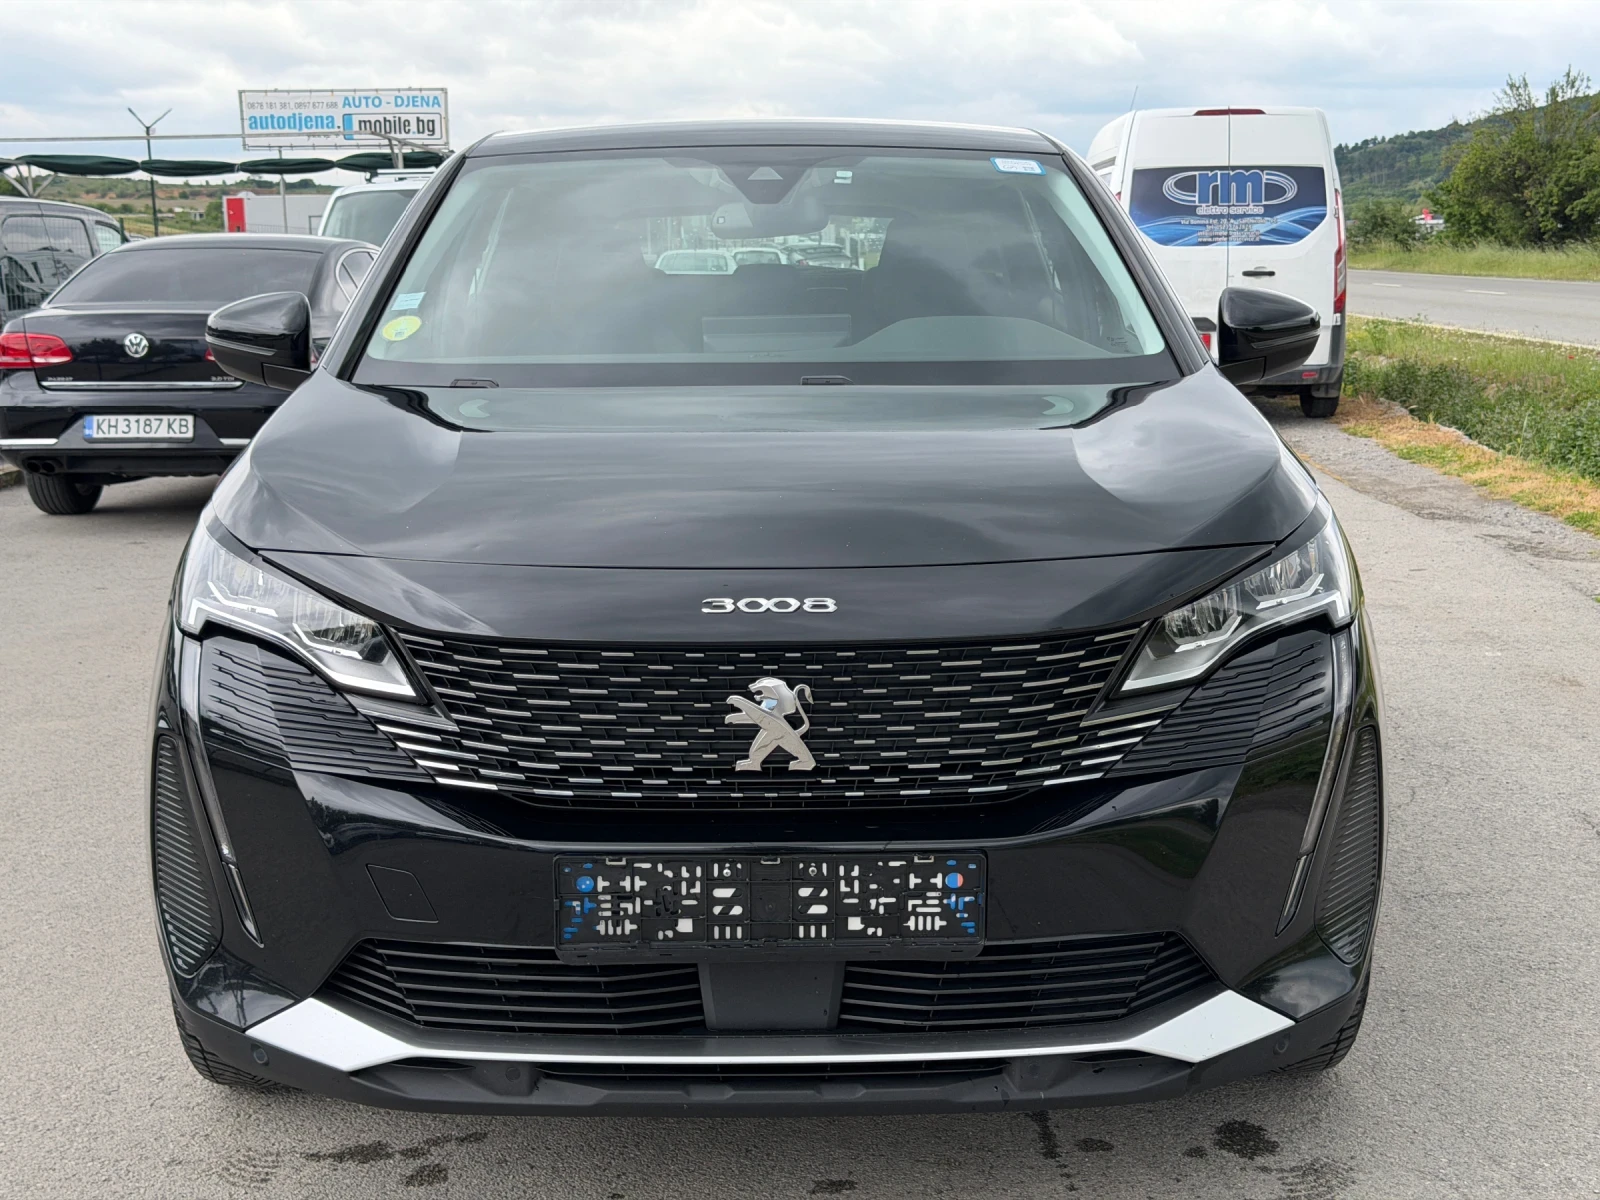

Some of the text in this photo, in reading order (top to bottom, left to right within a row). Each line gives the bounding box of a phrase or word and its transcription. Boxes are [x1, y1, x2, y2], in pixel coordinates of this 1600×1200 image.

[342, 96, 383, 108] AUTO
[394, 95, 441, 108] DJENA
[358, 115, 436, 136] mobile.bg
[1196, 169, 1264, 205] rm
[1196, 205, 1264, 215] elettro service
[701, 597, 838, 613] 3008
